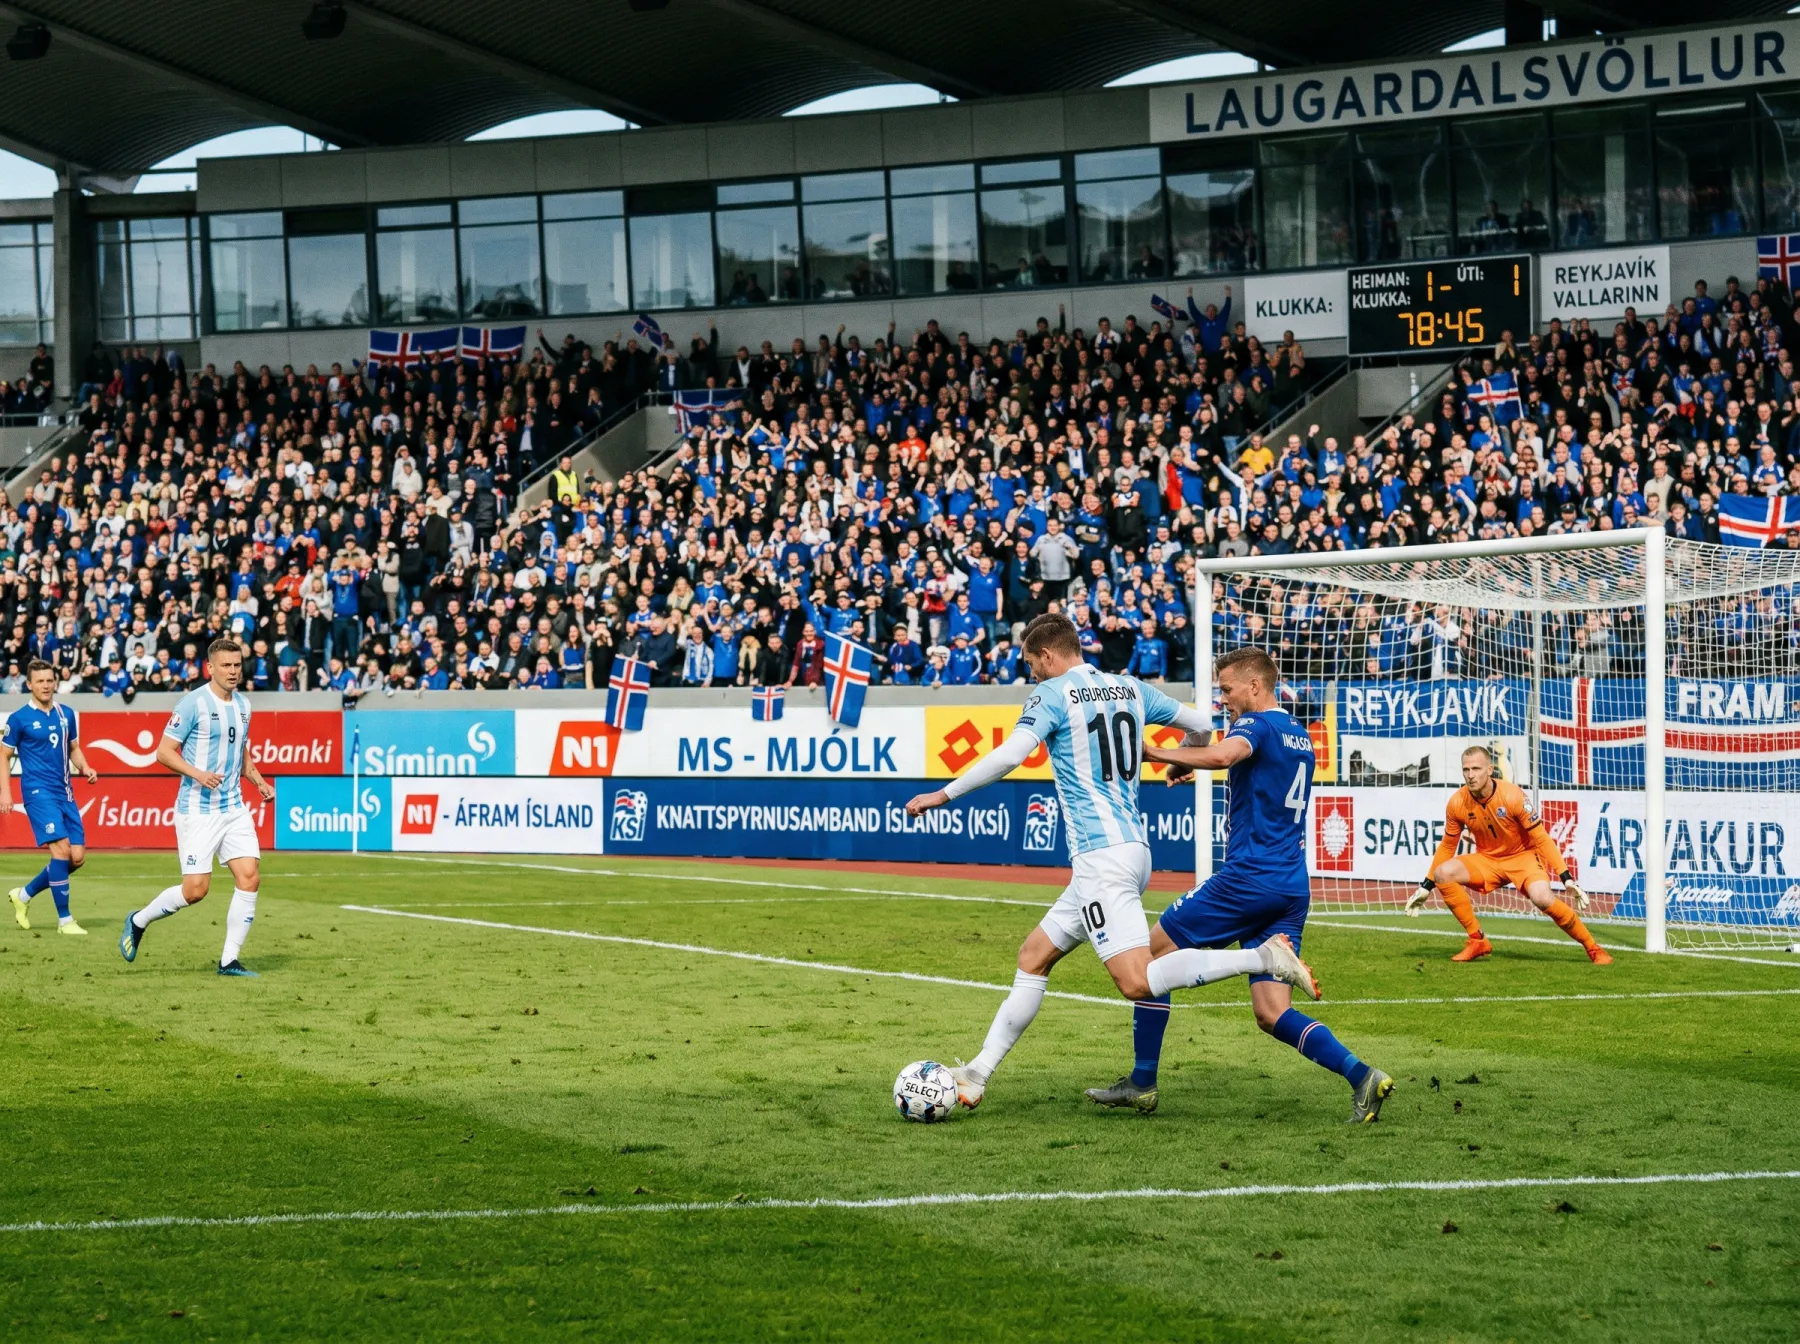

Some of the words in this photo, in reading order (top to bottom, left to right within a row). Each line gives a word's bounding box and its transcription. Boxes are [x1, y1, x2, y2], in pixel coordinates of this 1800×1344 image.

[1185, 31, 1787, 134] LAUGARDALSVÖLLUR
[1352, 271, 1410, 290] HEIMAN:
[1457, 263, 1484, 282] ÚTI:
[1513, 264, 1520, 296] 1
[1555, 255, 1656, 284] REYKJAVÍK
[1256, 297, 1333, 318] KLUKKA:
[1352, 291, 1411, 309] KLUKKA:
[1553, 284, 1658, 308] VALLARINN
[1398, 308, 1484, 346] 78:45
[1070, 686, 1136, 704] SIGURDSSON
[1345, 680, 1511, 726] REYKJAVÍK
[1679, 682, 1785, 719] FRAM
[49, 732, 59, 748] 9
[228, 726, 236, 744] 9
[678, 737, 733, 772] MS
[767, 728, 898, 773] MJÓLK
[1088, 711, 1138, 782] 10
[249, 738, 332, 764] sbanki
[365, 744, 477, 775] Síminn
[562, 736, 608, 769] N1
[1285, 762, 1307, 824] 4
[289, 805, 367, 832] Síminn
[407, 803, 432, 825] N1
[455, 798, 519, 827] ÁFRAM
[526, 798, 593, 828] ÍSLAND
[656, 804, 881, 832] KNATTSPYRNUSAMBAND
[886, 801, 963, 835] ÍSLANDS
[968, 803, 1010, 841] (KSÍ)
[1158, 807, 1227, 842] MJÓK
[1488, 824, 1497, 839] 1
[1082, 901, 1105, 933] 10
[904, 1082, 940, 1100] SELECT
